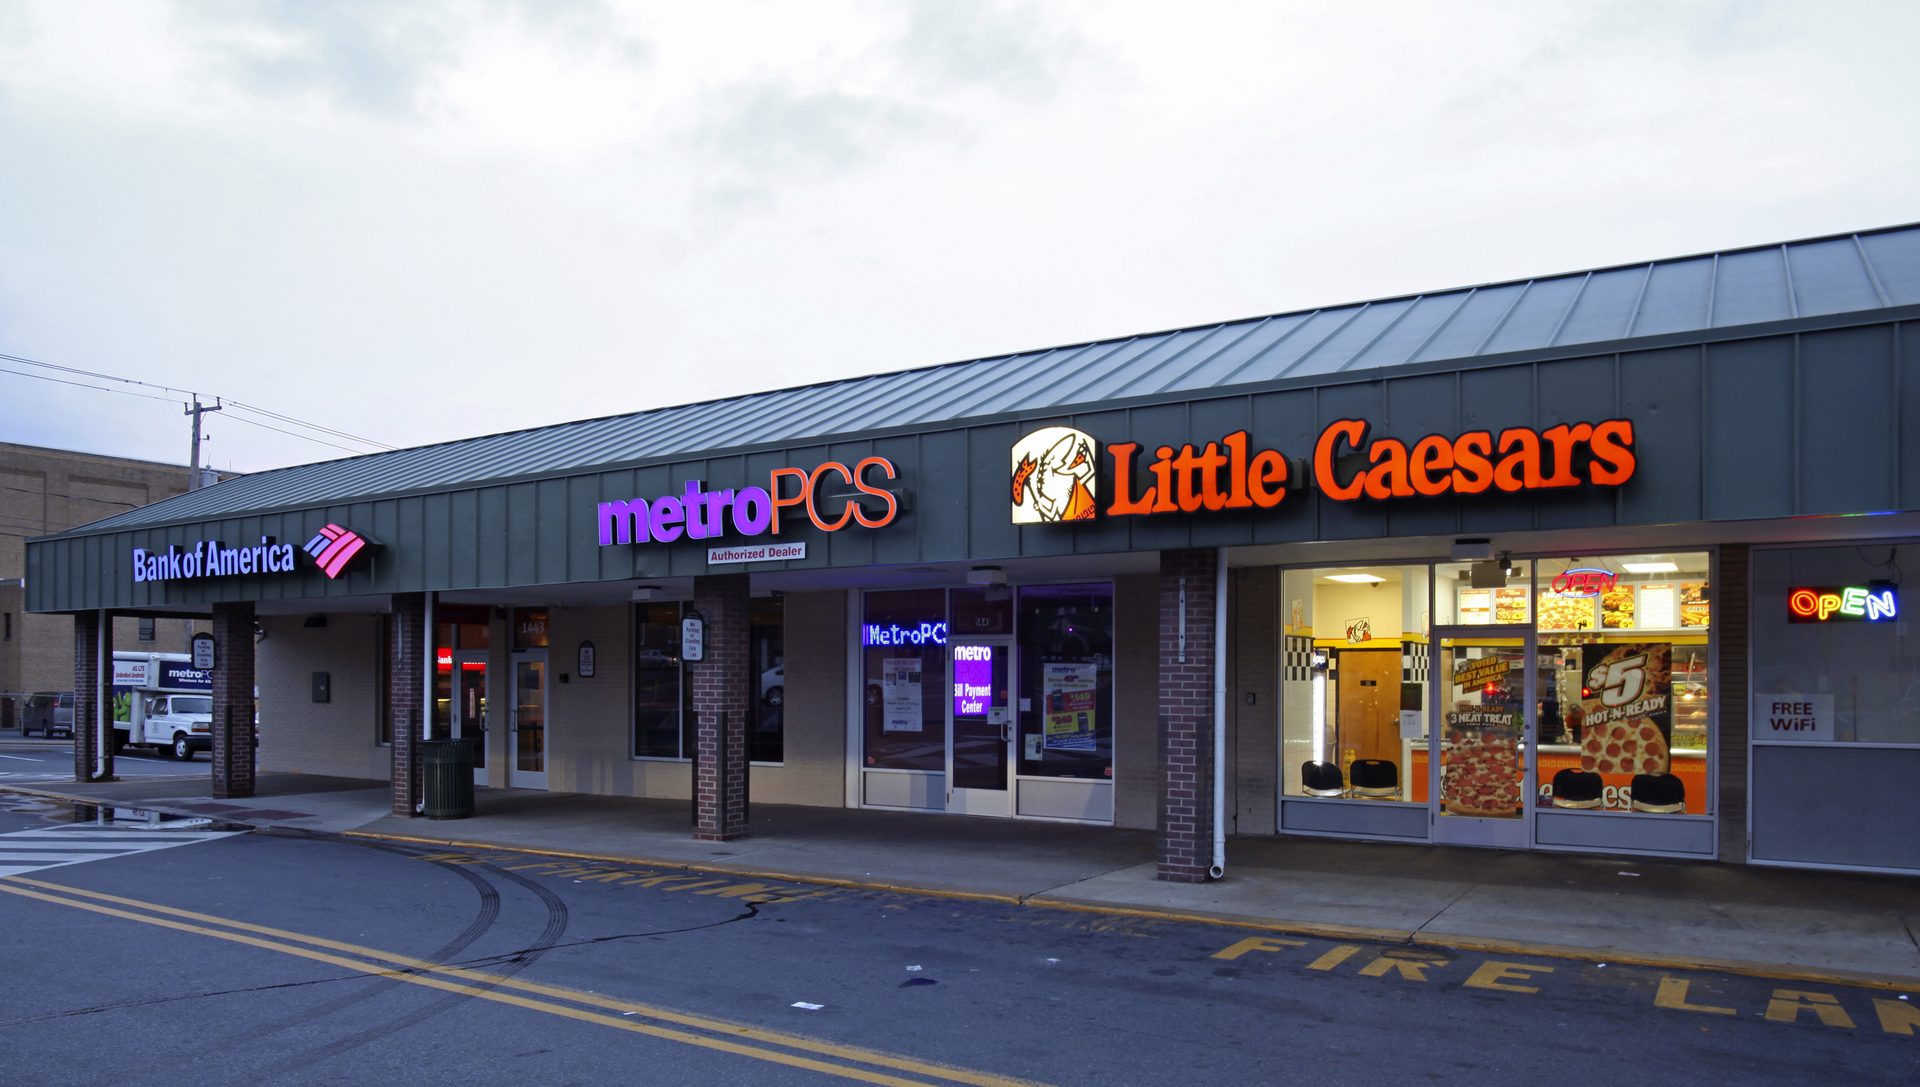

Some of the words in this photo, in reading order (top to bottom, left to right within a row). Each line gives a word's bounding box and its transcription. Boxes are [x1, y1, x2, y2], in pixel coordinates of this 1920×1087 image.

[1106, 429, 1288, 517] Little
[1313, 417, 1637, 502] Caesars
[597, 456, 897, 547] metroPCS
[133, 544, 181, 582] Bank
[183, 541, 203, 578] of
[205, 535, 295, 577] America
[710, 547, 765, 562] Authorized
[768, 546, 803, 558] Dealer
[1551, 572, 1619, 593] OPEN
[1790, 587, 1897, 621] OPEN
[522, 621, 545, 634] 1443
[954, 646, 992, 661] metro
[1471, 656, 1498, 670] VOTED
[168, 668, 213, 679] metroPC
[961, 662, 985, 682] PCS
[1455, 668, 1478, 684] BEST
[1478, 661, 1508, 677] VALUE
[1587, 653, 1649, 708] $5
[1463, 680, 1471, 689] IN
[1472, 673, 1503, 687] AMERICA
[964, 683, 991, 700] Payment
[961, 700, 983, 713] Center
[1585, 694, 1668, 727] HOT-N-READY
[1772, 702, 1813, 715] FREE
[1450, 713, 1458, 724] 3
[1458, 714, 1482, 724] MEAT
[1483, 714, 1513, 726] TREAT
[1770, 718, 1816, 731] WiFi
[1210, 936, 1555, 994] FIRE
